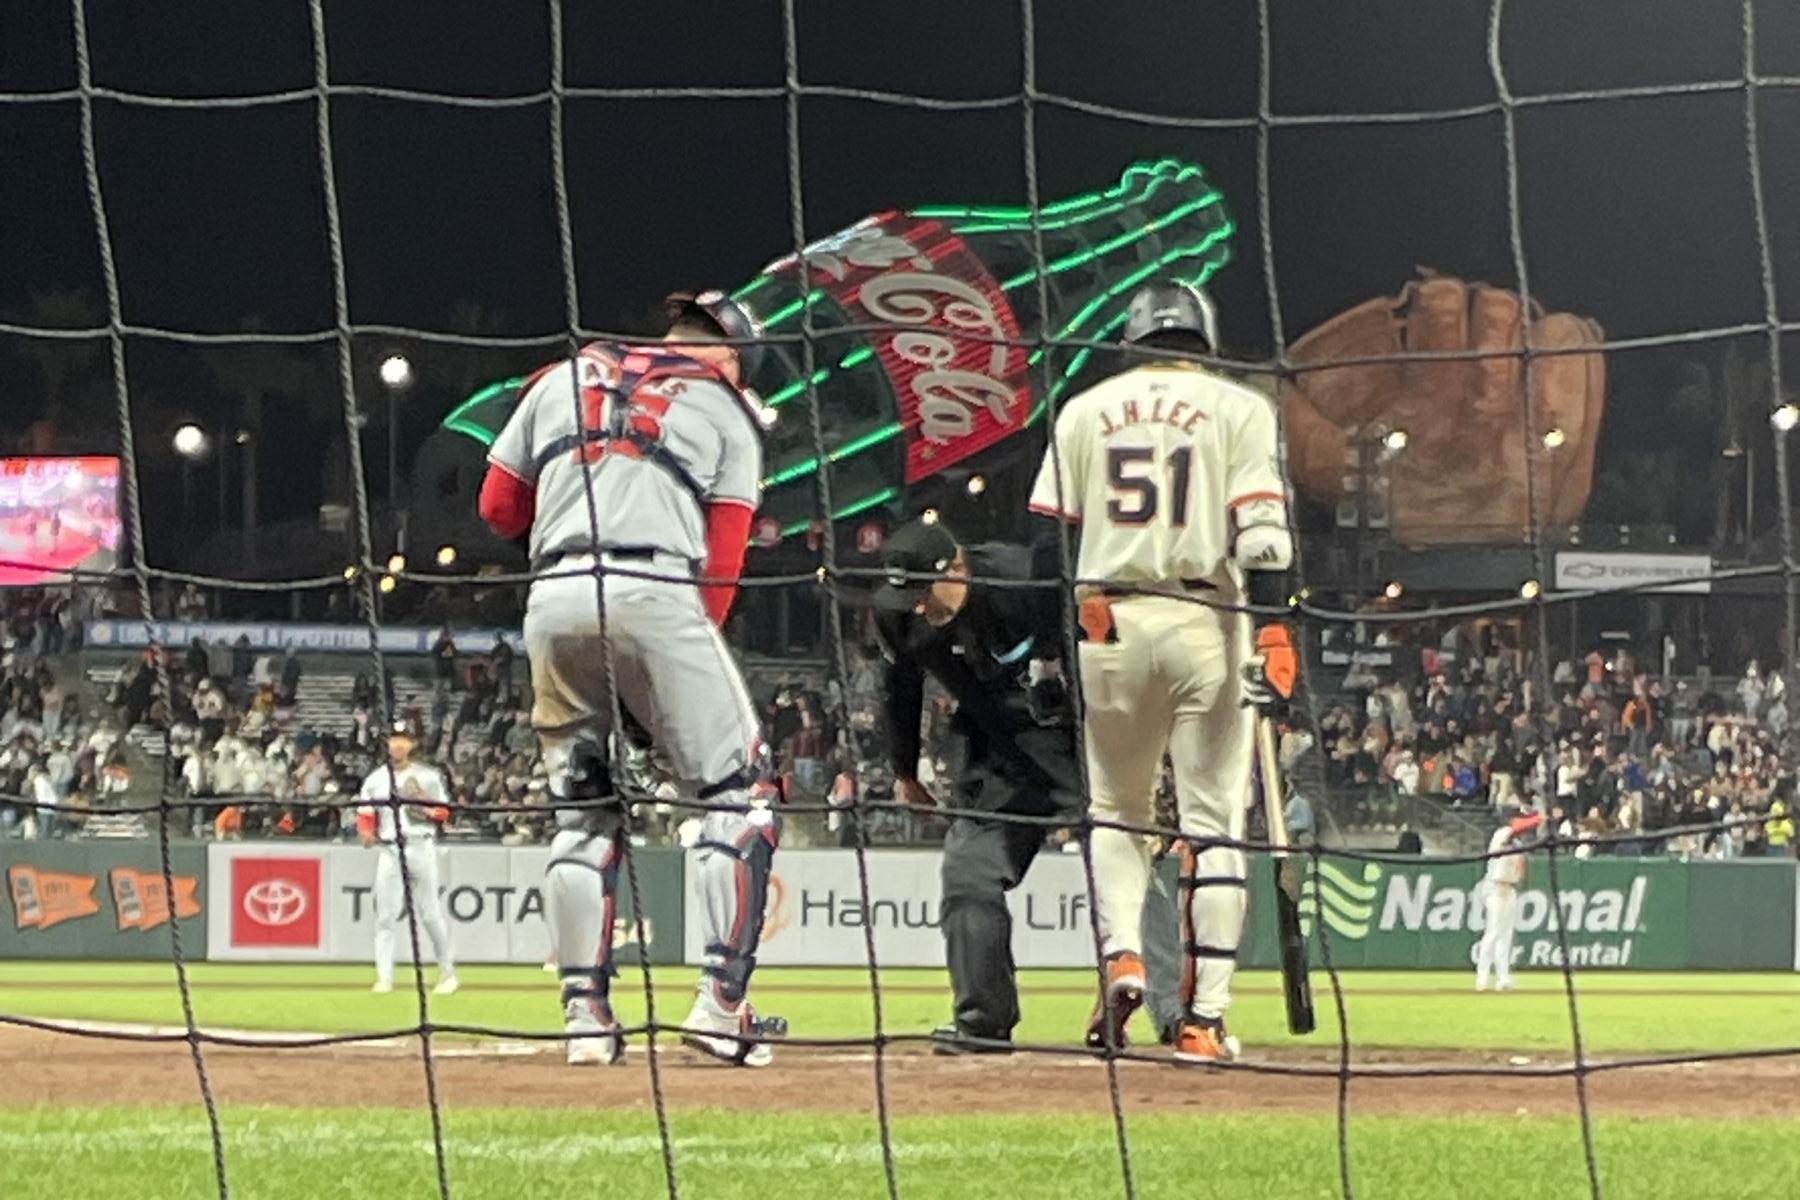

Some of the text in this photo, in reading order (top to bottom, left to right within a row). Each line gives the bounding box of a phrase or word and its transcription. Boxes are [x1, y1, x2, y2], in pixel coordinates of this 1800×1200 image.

[1106, 445, 1197, 529] 51
[342, 886, 546, 922] TOTA
[801, 889, 1089, 931] Hanw Lif
[1378, 873, 1648, 933] Natonal
[1470, 939, 1632, 966] Cr Rental
